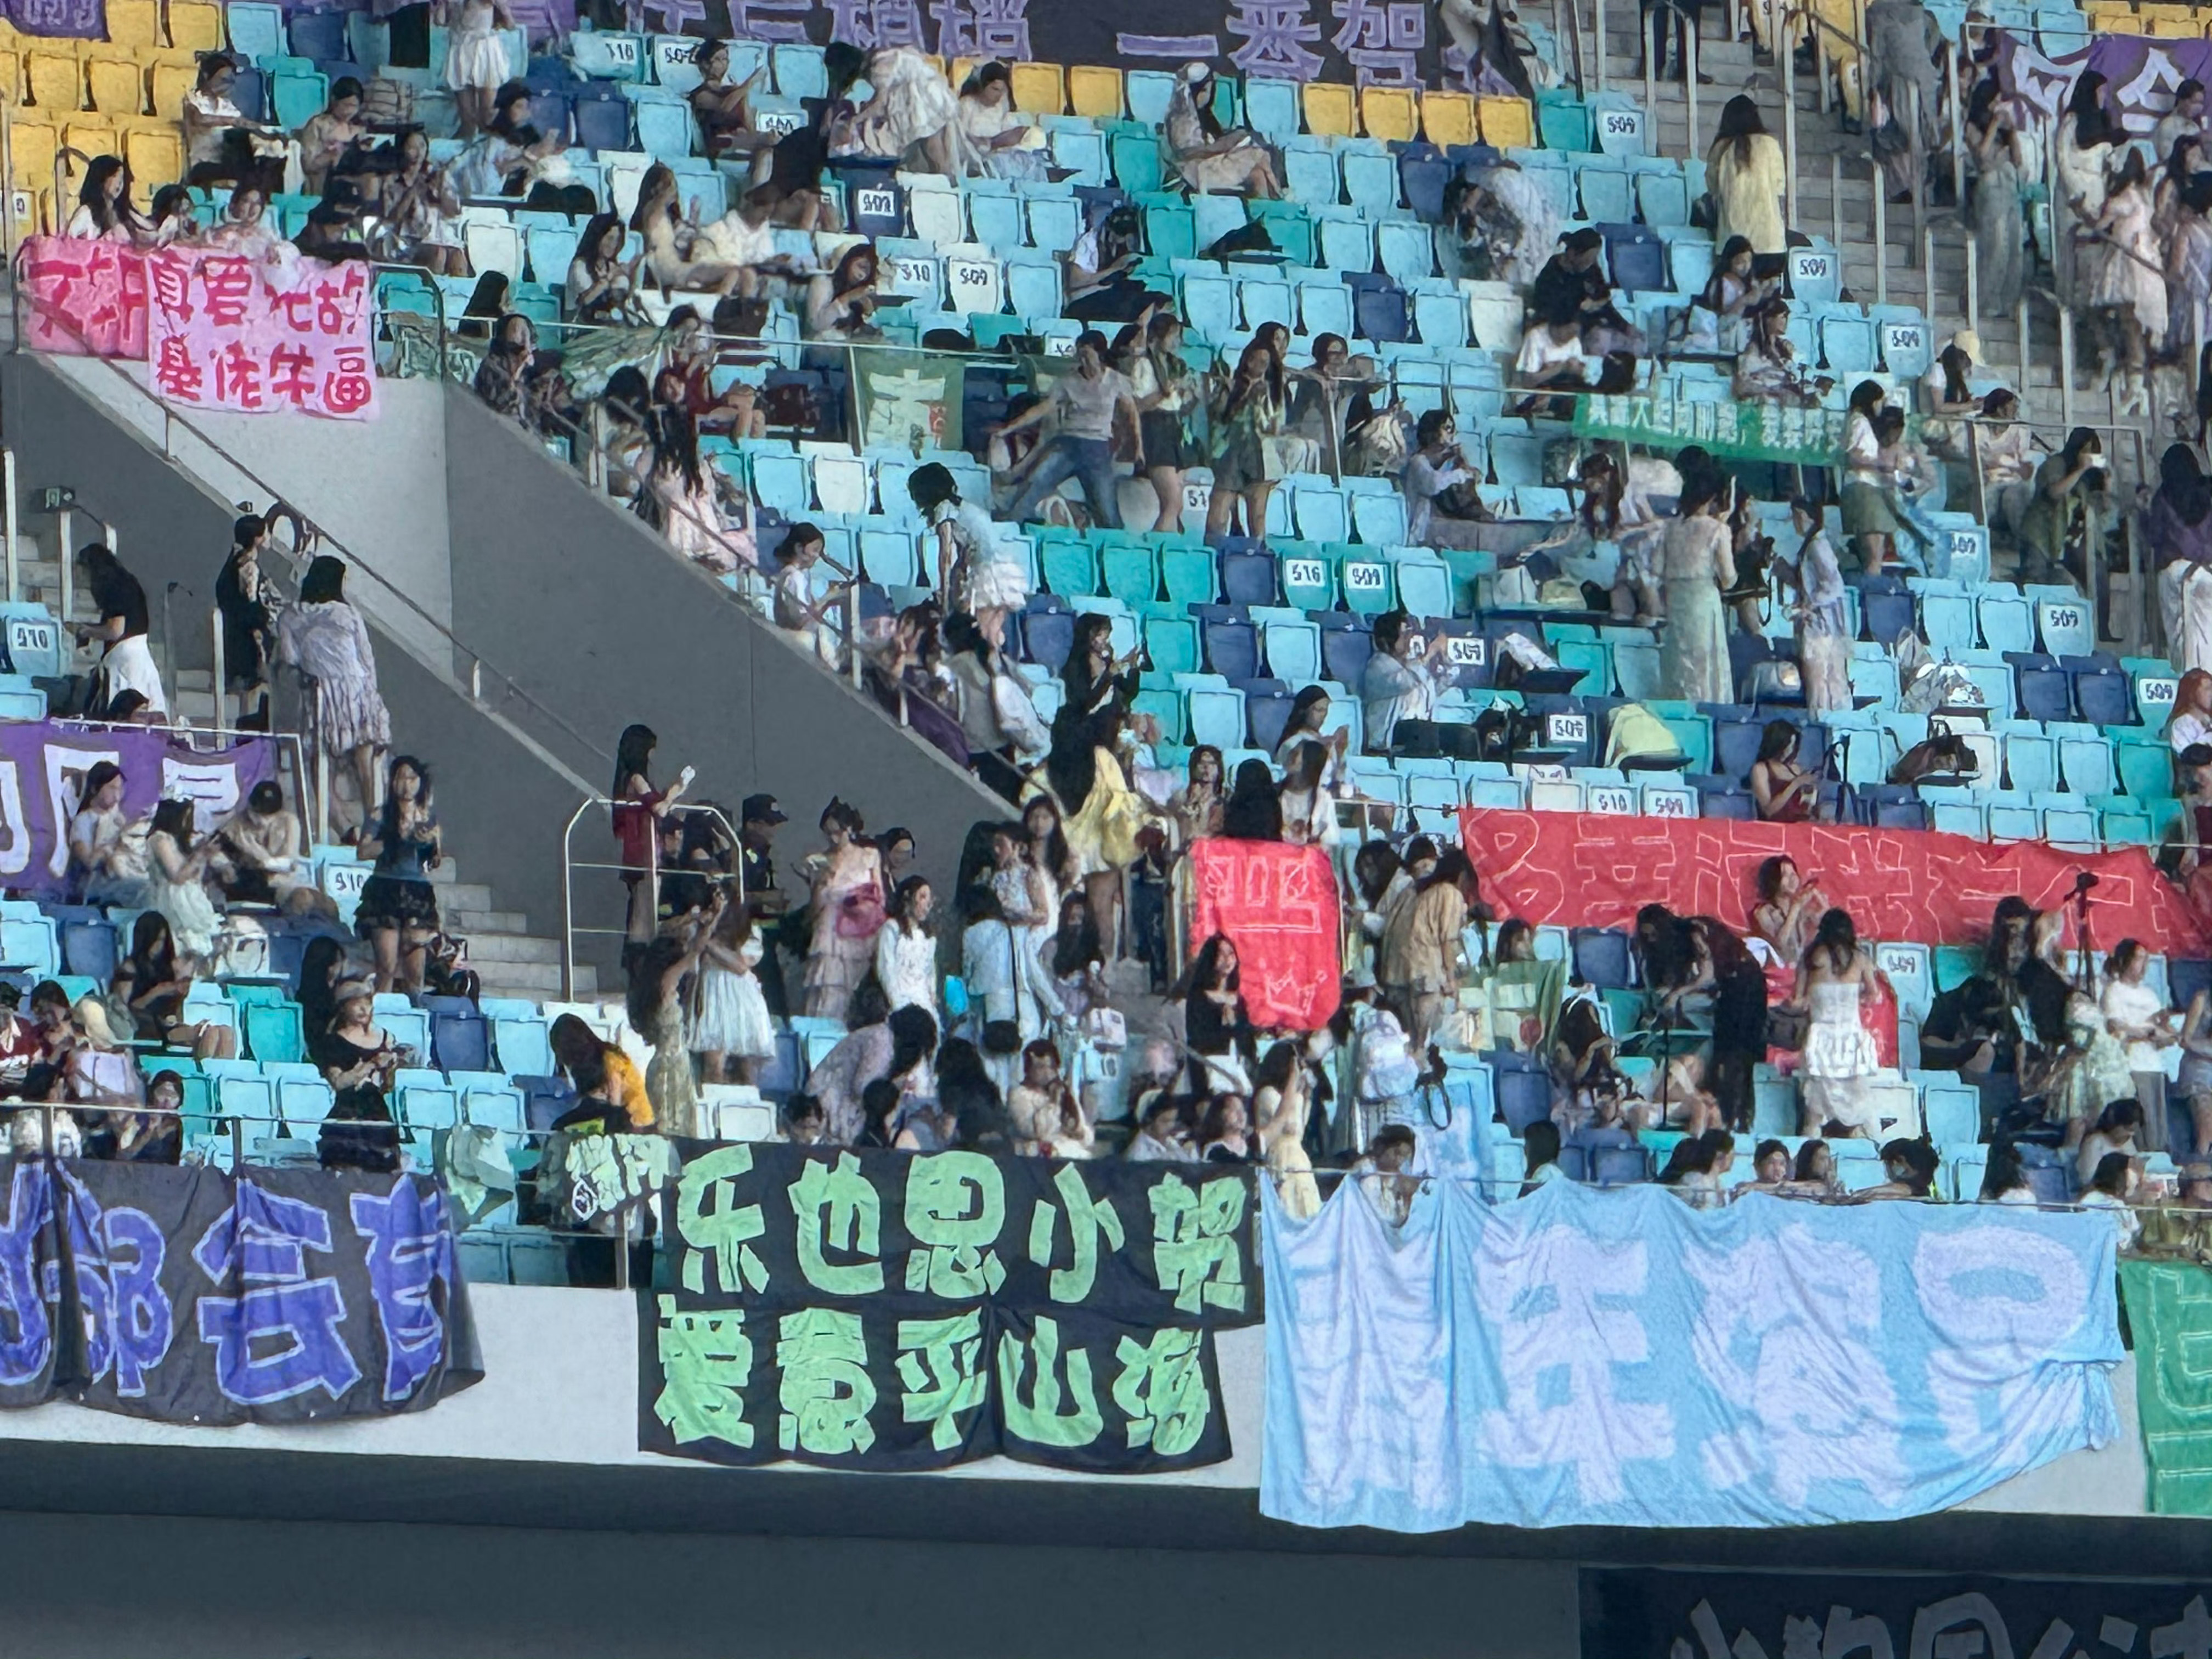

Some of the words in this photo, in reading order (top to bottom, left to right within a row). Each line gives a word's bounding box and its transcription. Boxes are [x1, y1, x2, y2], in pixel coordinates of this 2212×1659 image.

[2051, 611, 2078, 627] 509
[2146, 684, 2173, 701] 509
[1598, 793, 1628, 812] 510
